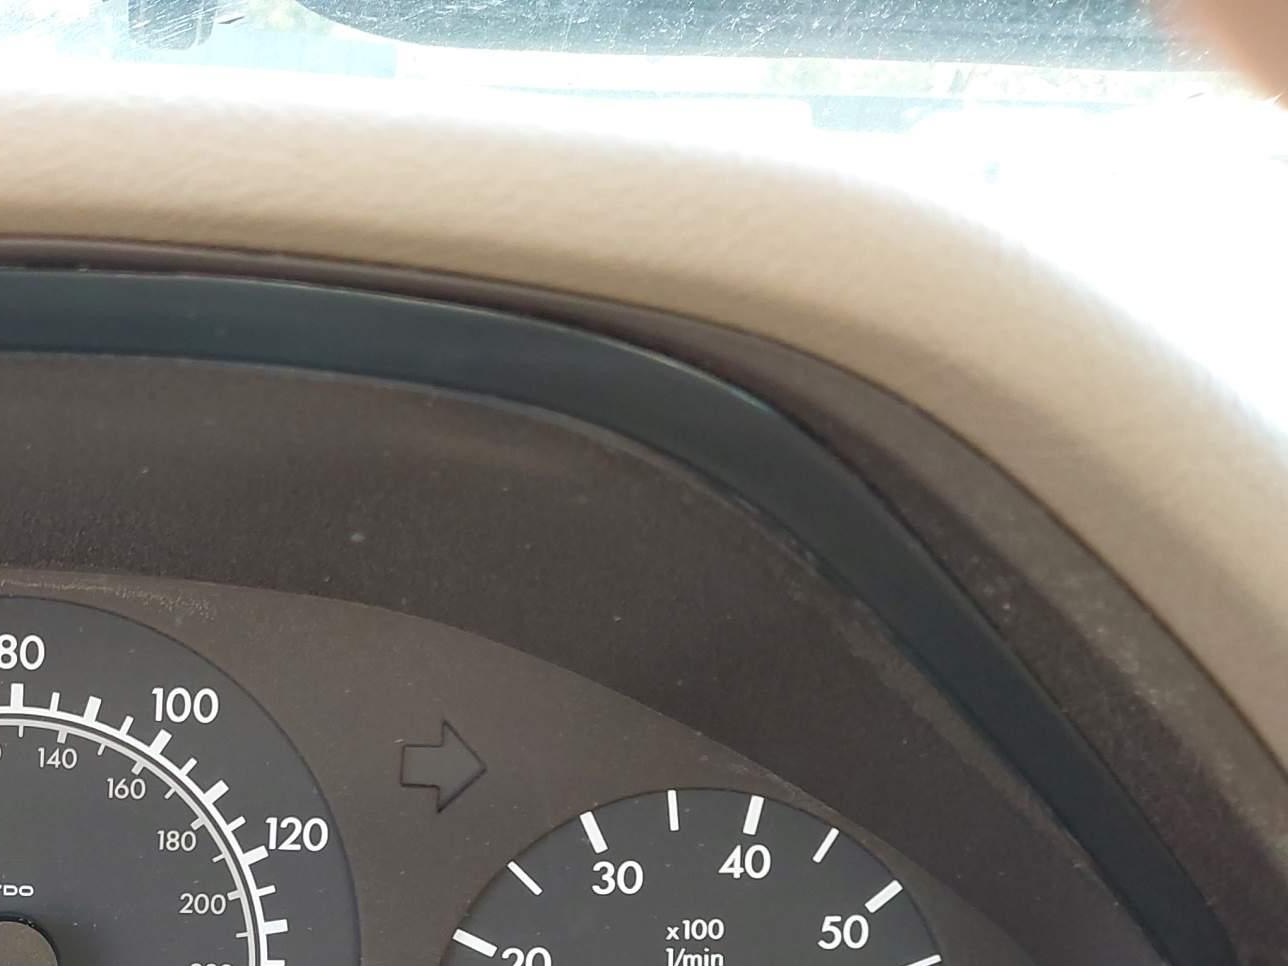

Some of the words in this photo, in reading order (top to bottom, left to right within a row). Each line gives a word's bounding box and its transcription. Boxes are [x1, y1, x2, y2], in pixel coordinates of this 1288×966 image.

[151, 687, 219, 724] 100
[38, 747, 78, 769] 140
[107, 777, 146, 800] 160
[157, 830, 197, 852] 180
[265, 816, 329, 852] 120
[718, 844, 771, 879] 40
[591, 860, 644, 895] 30
[179, 892, 226, 915] 200
[665, 918, 725, 940] x100
[817, 914, 869, 950] 50
